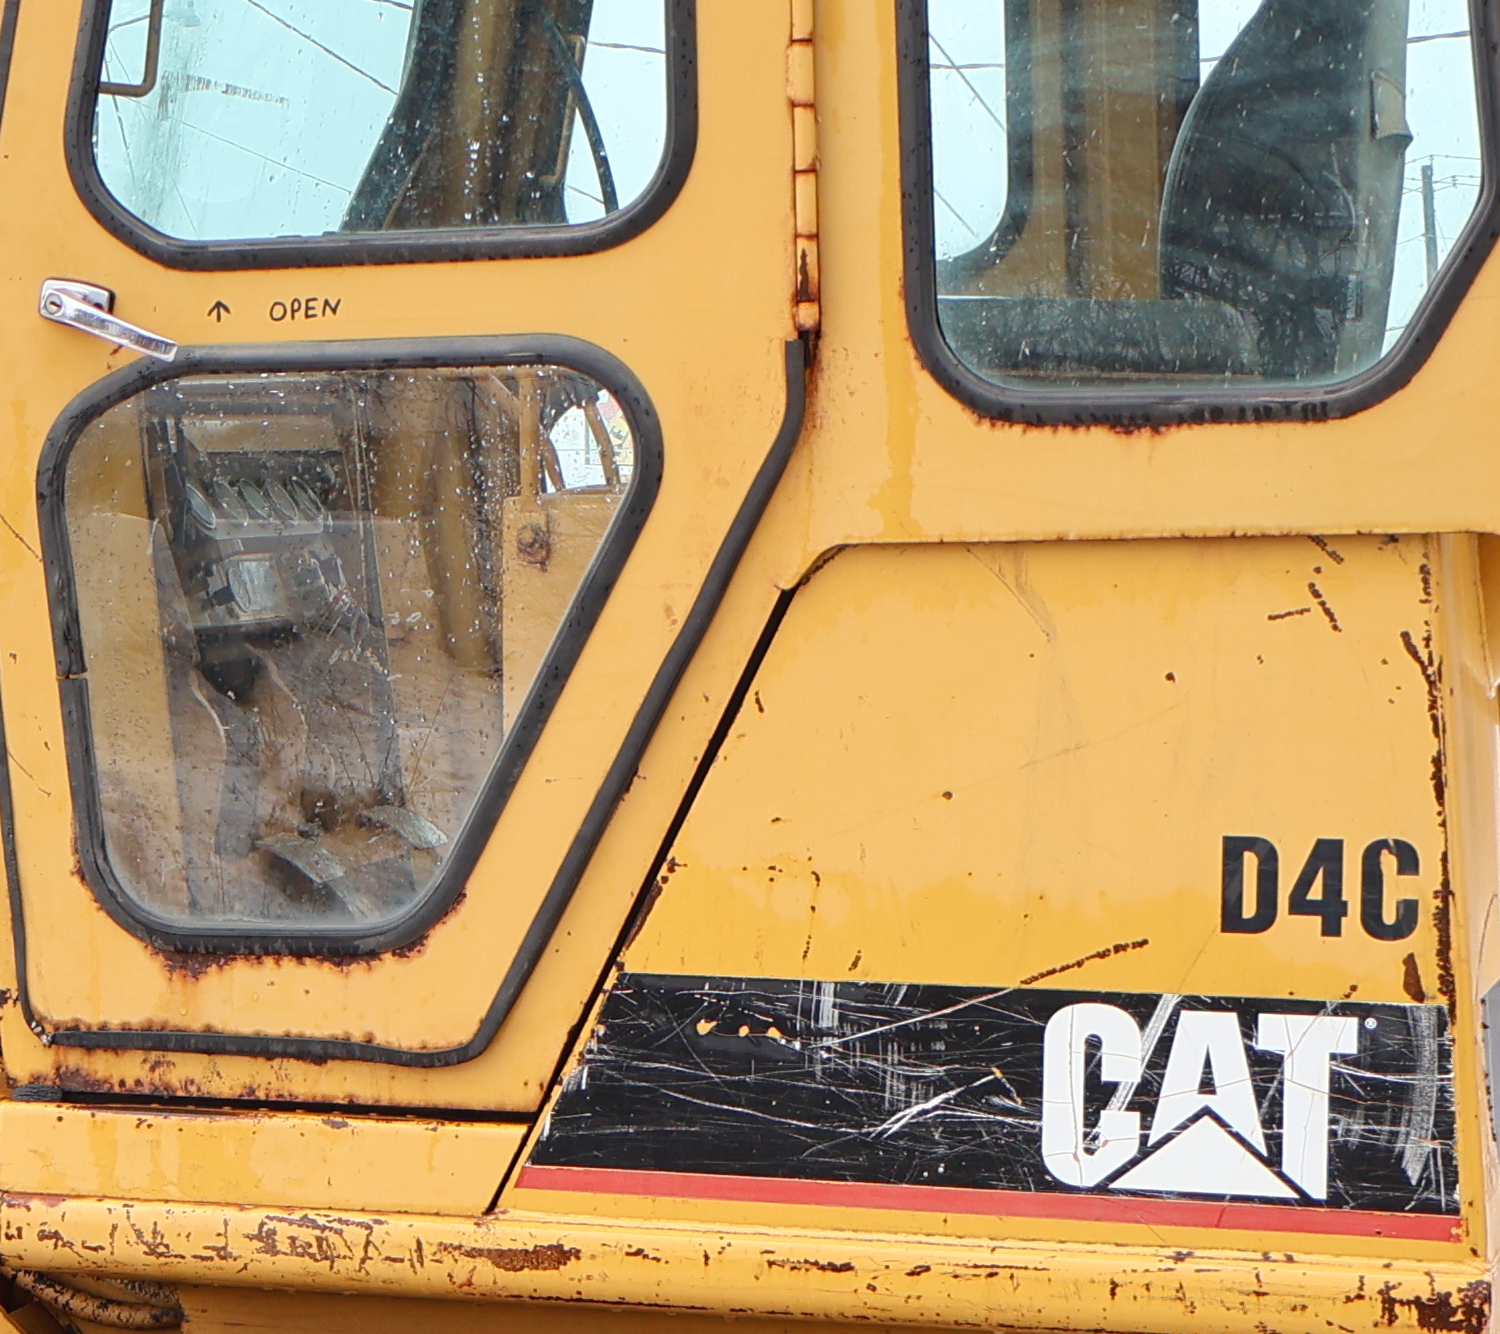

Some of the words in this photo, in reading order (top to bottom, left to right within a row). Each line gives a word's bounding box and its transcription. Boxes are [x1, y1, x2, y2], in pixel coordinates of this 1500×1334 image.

[268, 297, 342, 322] OPEN
[1220, 834, 1421, 942] D4C
[1040, 1001, 1359, 1201] CAT
